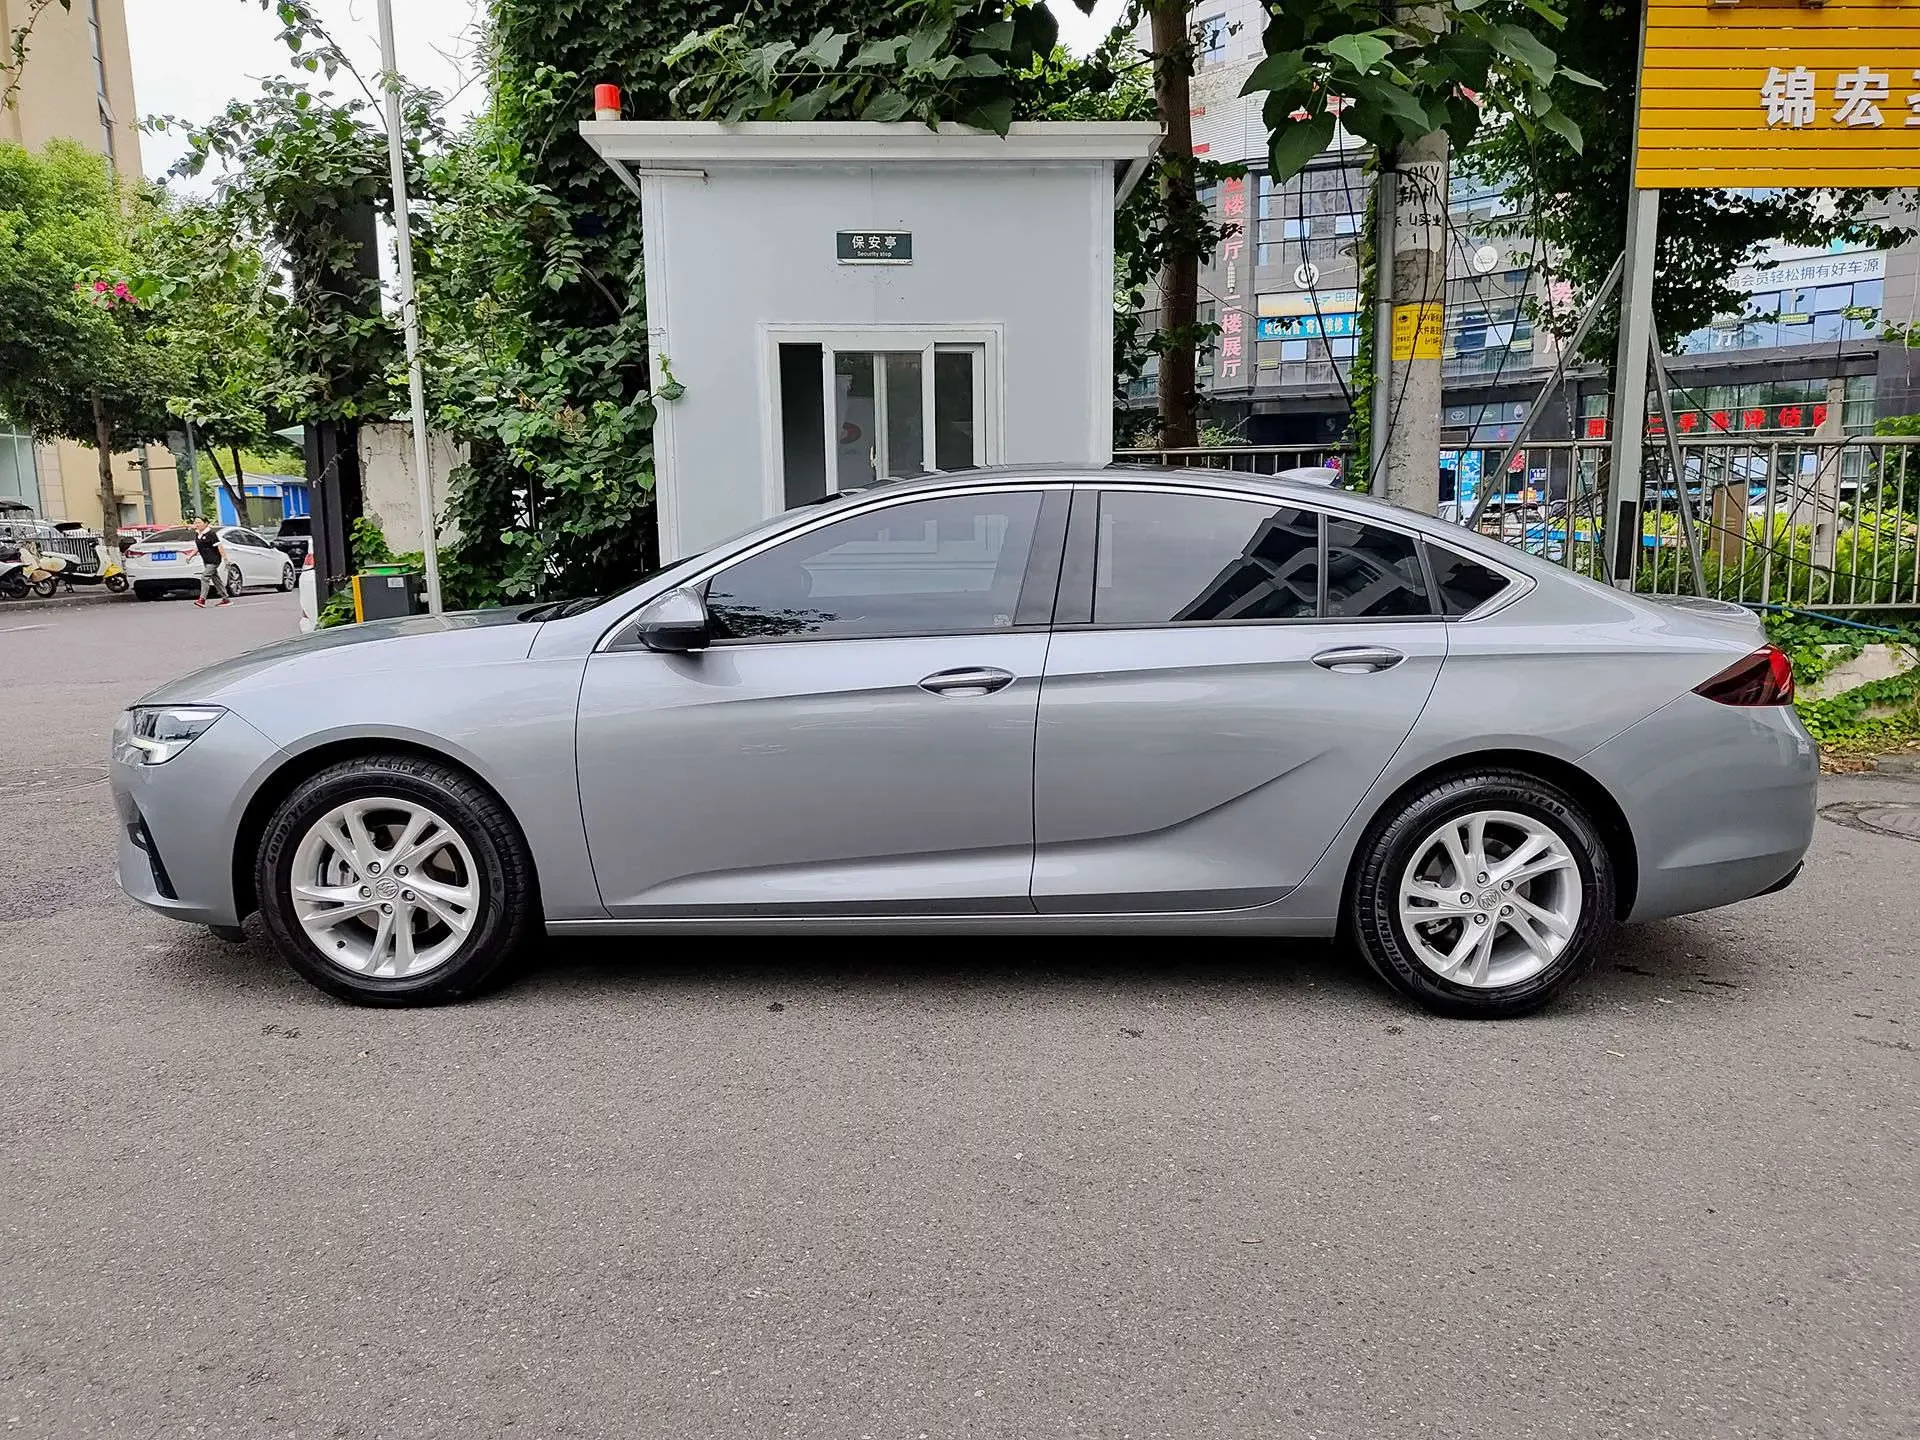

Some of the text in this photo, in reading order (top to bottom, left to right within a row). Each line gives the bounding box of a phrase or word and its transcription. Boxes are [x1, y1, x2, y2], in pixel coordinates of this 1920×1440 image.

[852, 235, 897, 249] 保安亭
[1221, 294, 1242, 378] 二楼展厅
